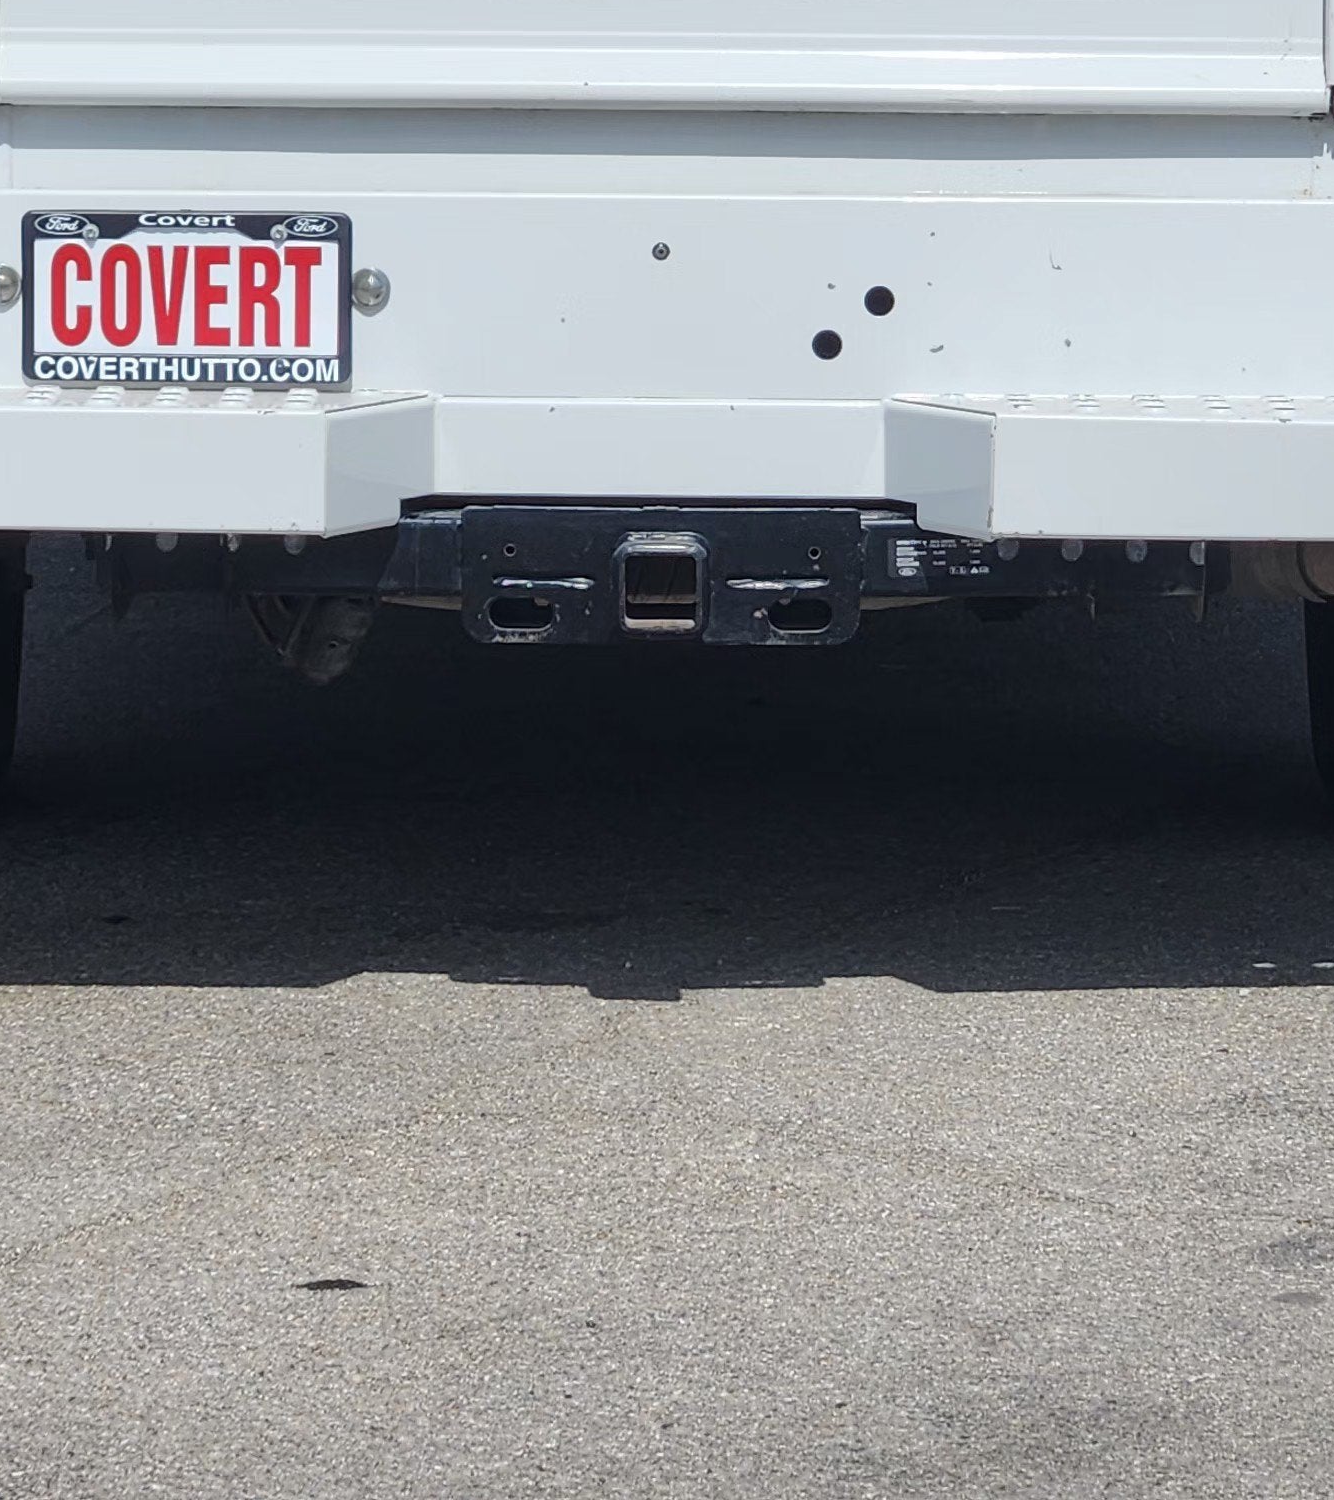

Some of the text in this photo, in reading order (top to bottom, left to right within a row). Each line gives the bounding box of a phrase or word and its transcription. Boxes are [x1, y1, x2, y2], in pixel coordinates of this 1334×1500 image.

[45, 216, 80, 231] Ford
[138, 213, 236, 227] Covert
[293, 217, 328, 233] Ford
[50, 243, 323, 348] COVERT
[33, 355, 340, 382] COVERTHUTTO.COM
